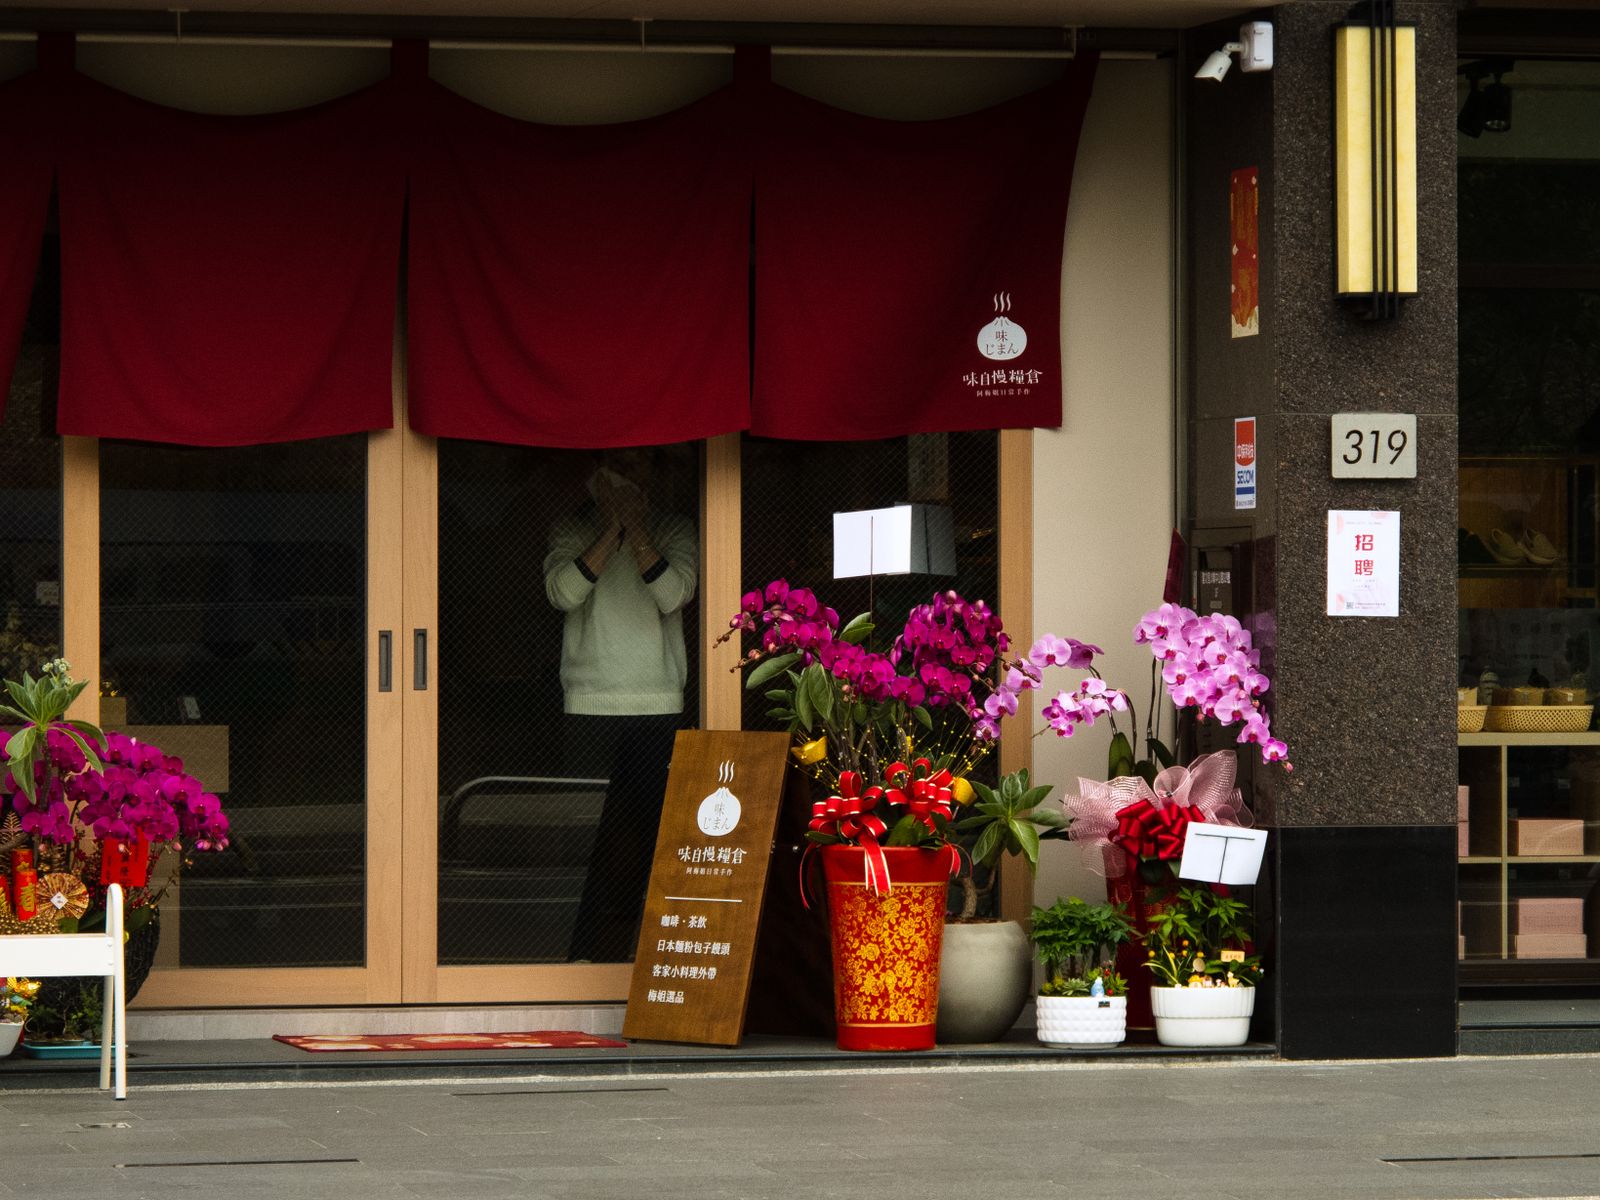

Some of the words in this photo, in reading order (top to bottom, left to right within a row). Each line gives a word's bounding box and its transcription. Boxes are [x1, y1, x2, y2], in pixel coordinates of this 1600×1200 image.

[962, 368, 1043, 387] 味自慢糧倉
[1342, 429, 1408, 465] 319
[1236, 469, 1254, 485] SECOM
[1354, 534, 1374, 577] 招聘
[677, 845, 748, 865] 味自慢糧倉
